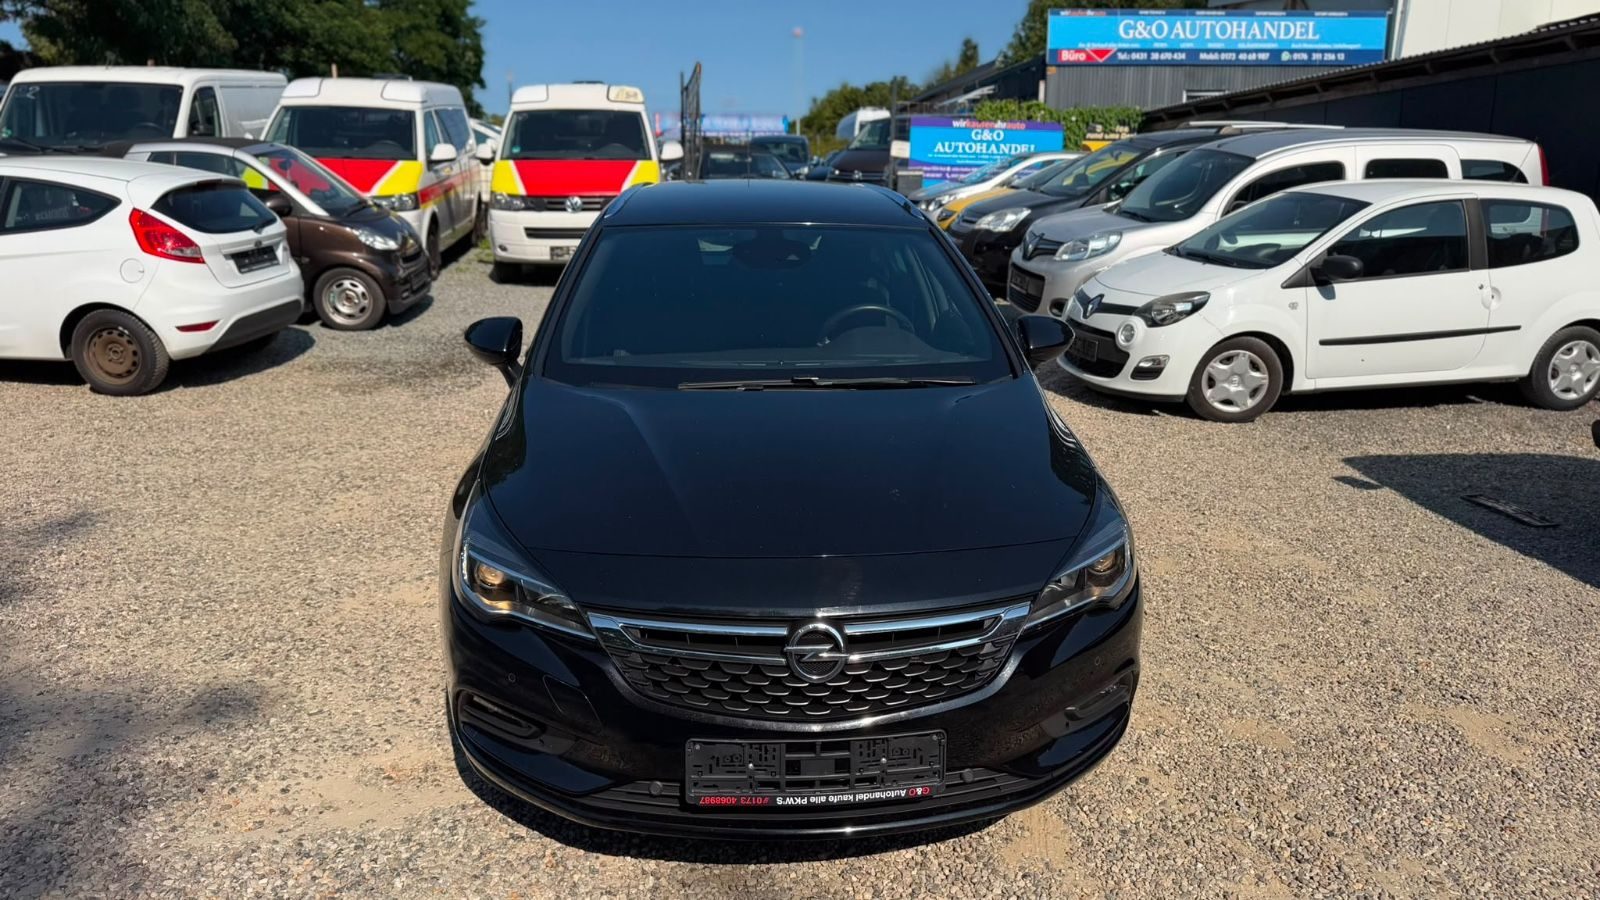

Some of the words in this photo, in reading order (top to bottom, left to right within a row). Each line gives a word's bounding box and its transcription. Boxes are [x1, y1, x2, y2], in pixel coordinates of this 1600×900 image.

[1118, 19, 1168, 39] G&O
[1170, 20, 1320, 40] AUTOHANDEL
[1061, 50, 1087, 61] Büro
[971, 129, 1004, 141] G&O
[855, 788, 907, 799] Autohandel
[908, 786, 931, 797] G&O
[810, 796, 827, 804] alle
[828, 793, 854, 802] kaufe
